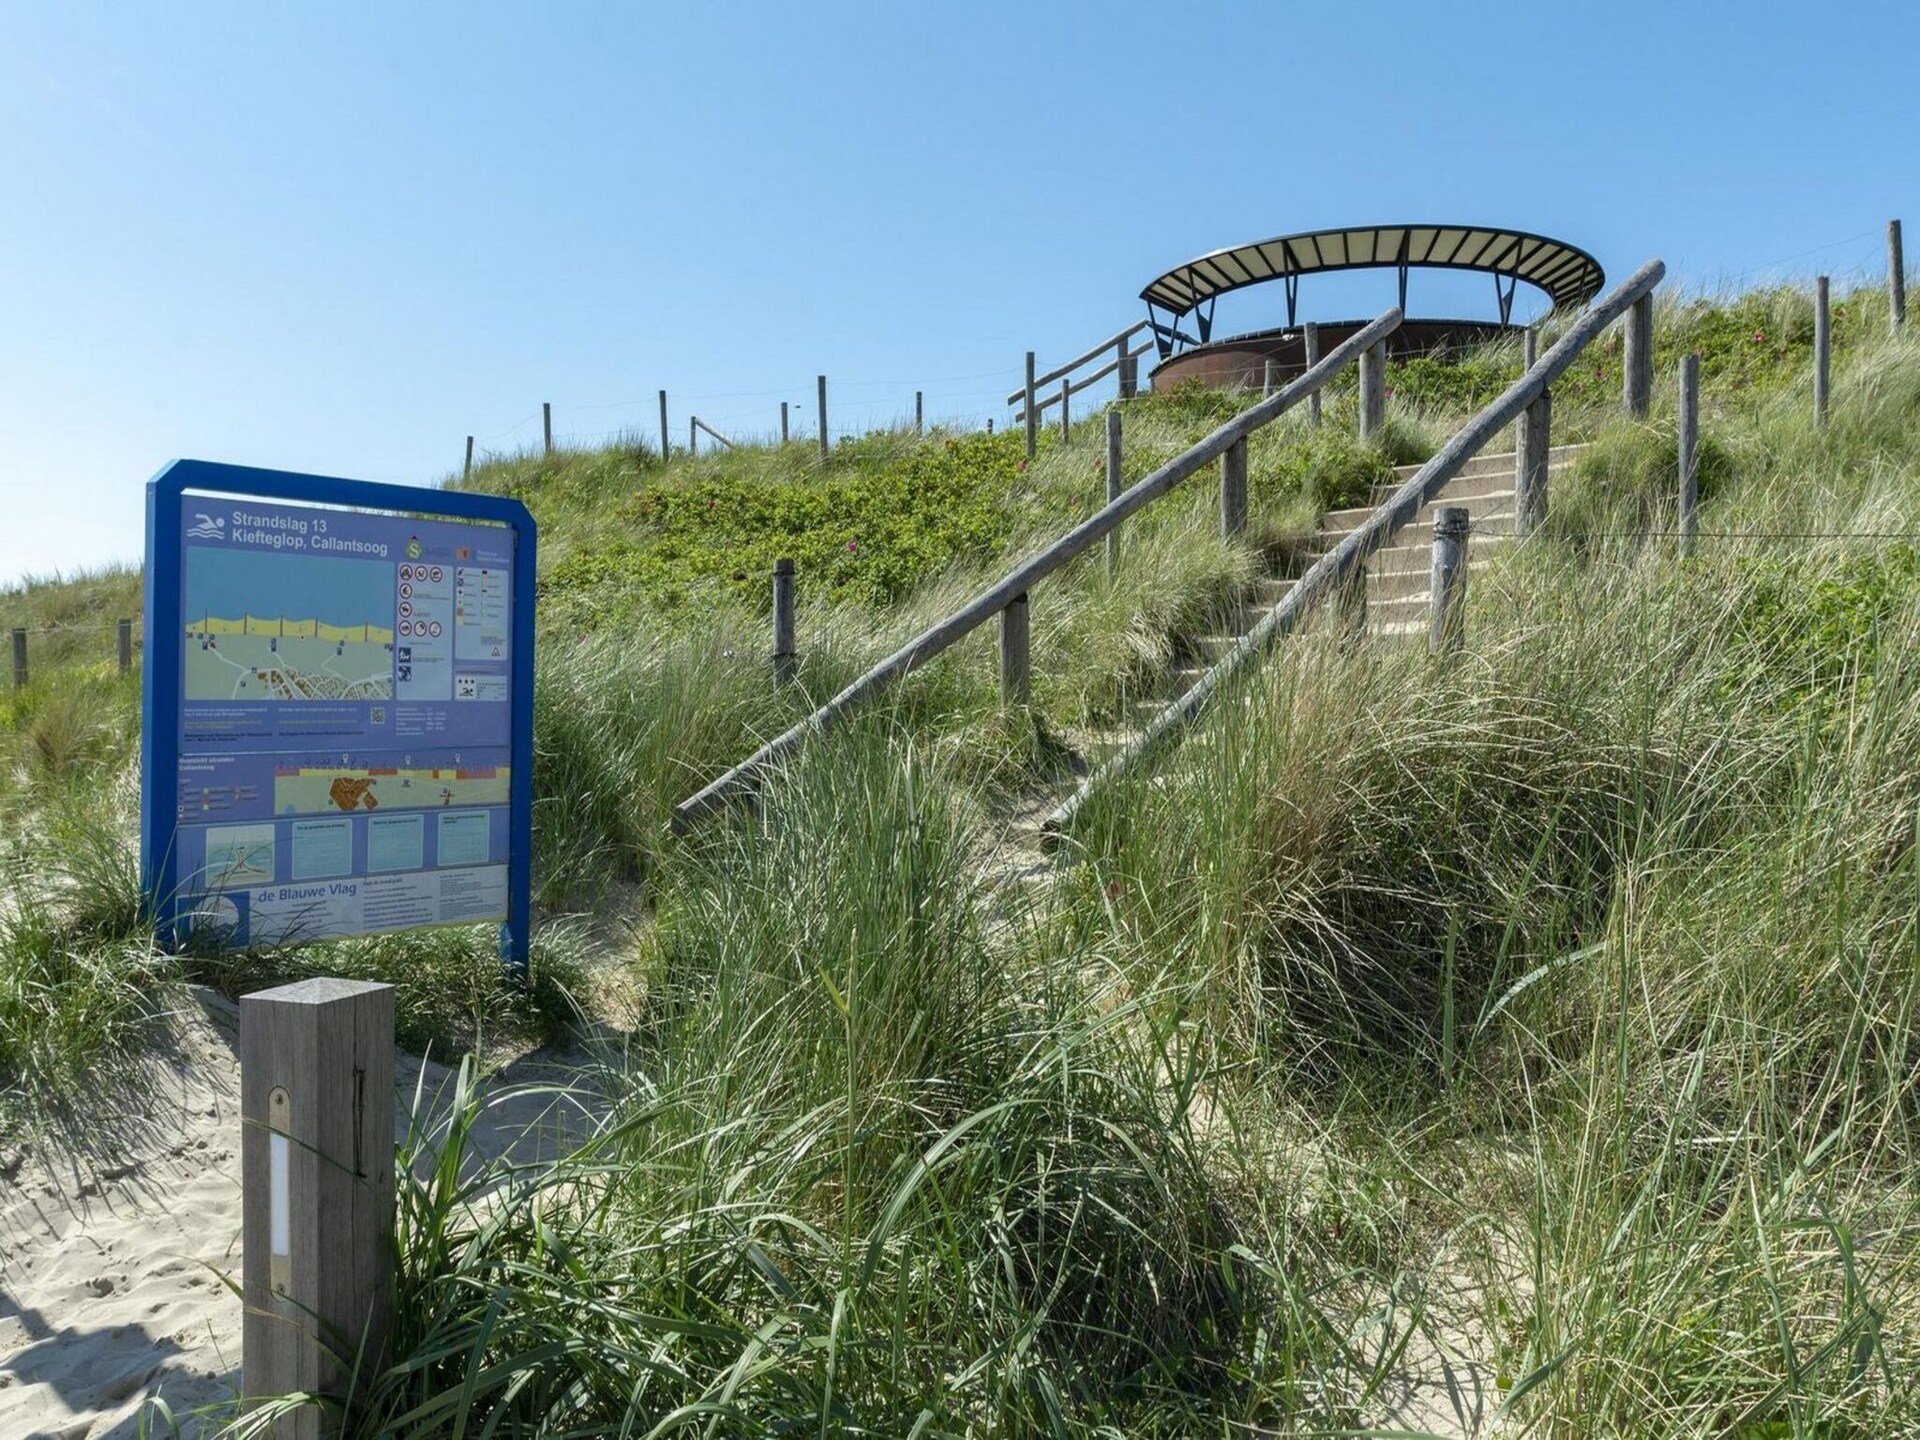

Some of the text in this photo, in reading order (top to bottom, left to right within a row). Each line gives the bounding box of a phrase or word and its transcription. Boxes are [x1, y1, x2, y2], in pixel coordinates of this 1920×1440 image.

[232, 511, 328, 534] Strandslag 13
[232, 528, 388, 557] Kiefteglop, Callantsoog
[258, 883, 358, 903] de Blauwe Vlag
